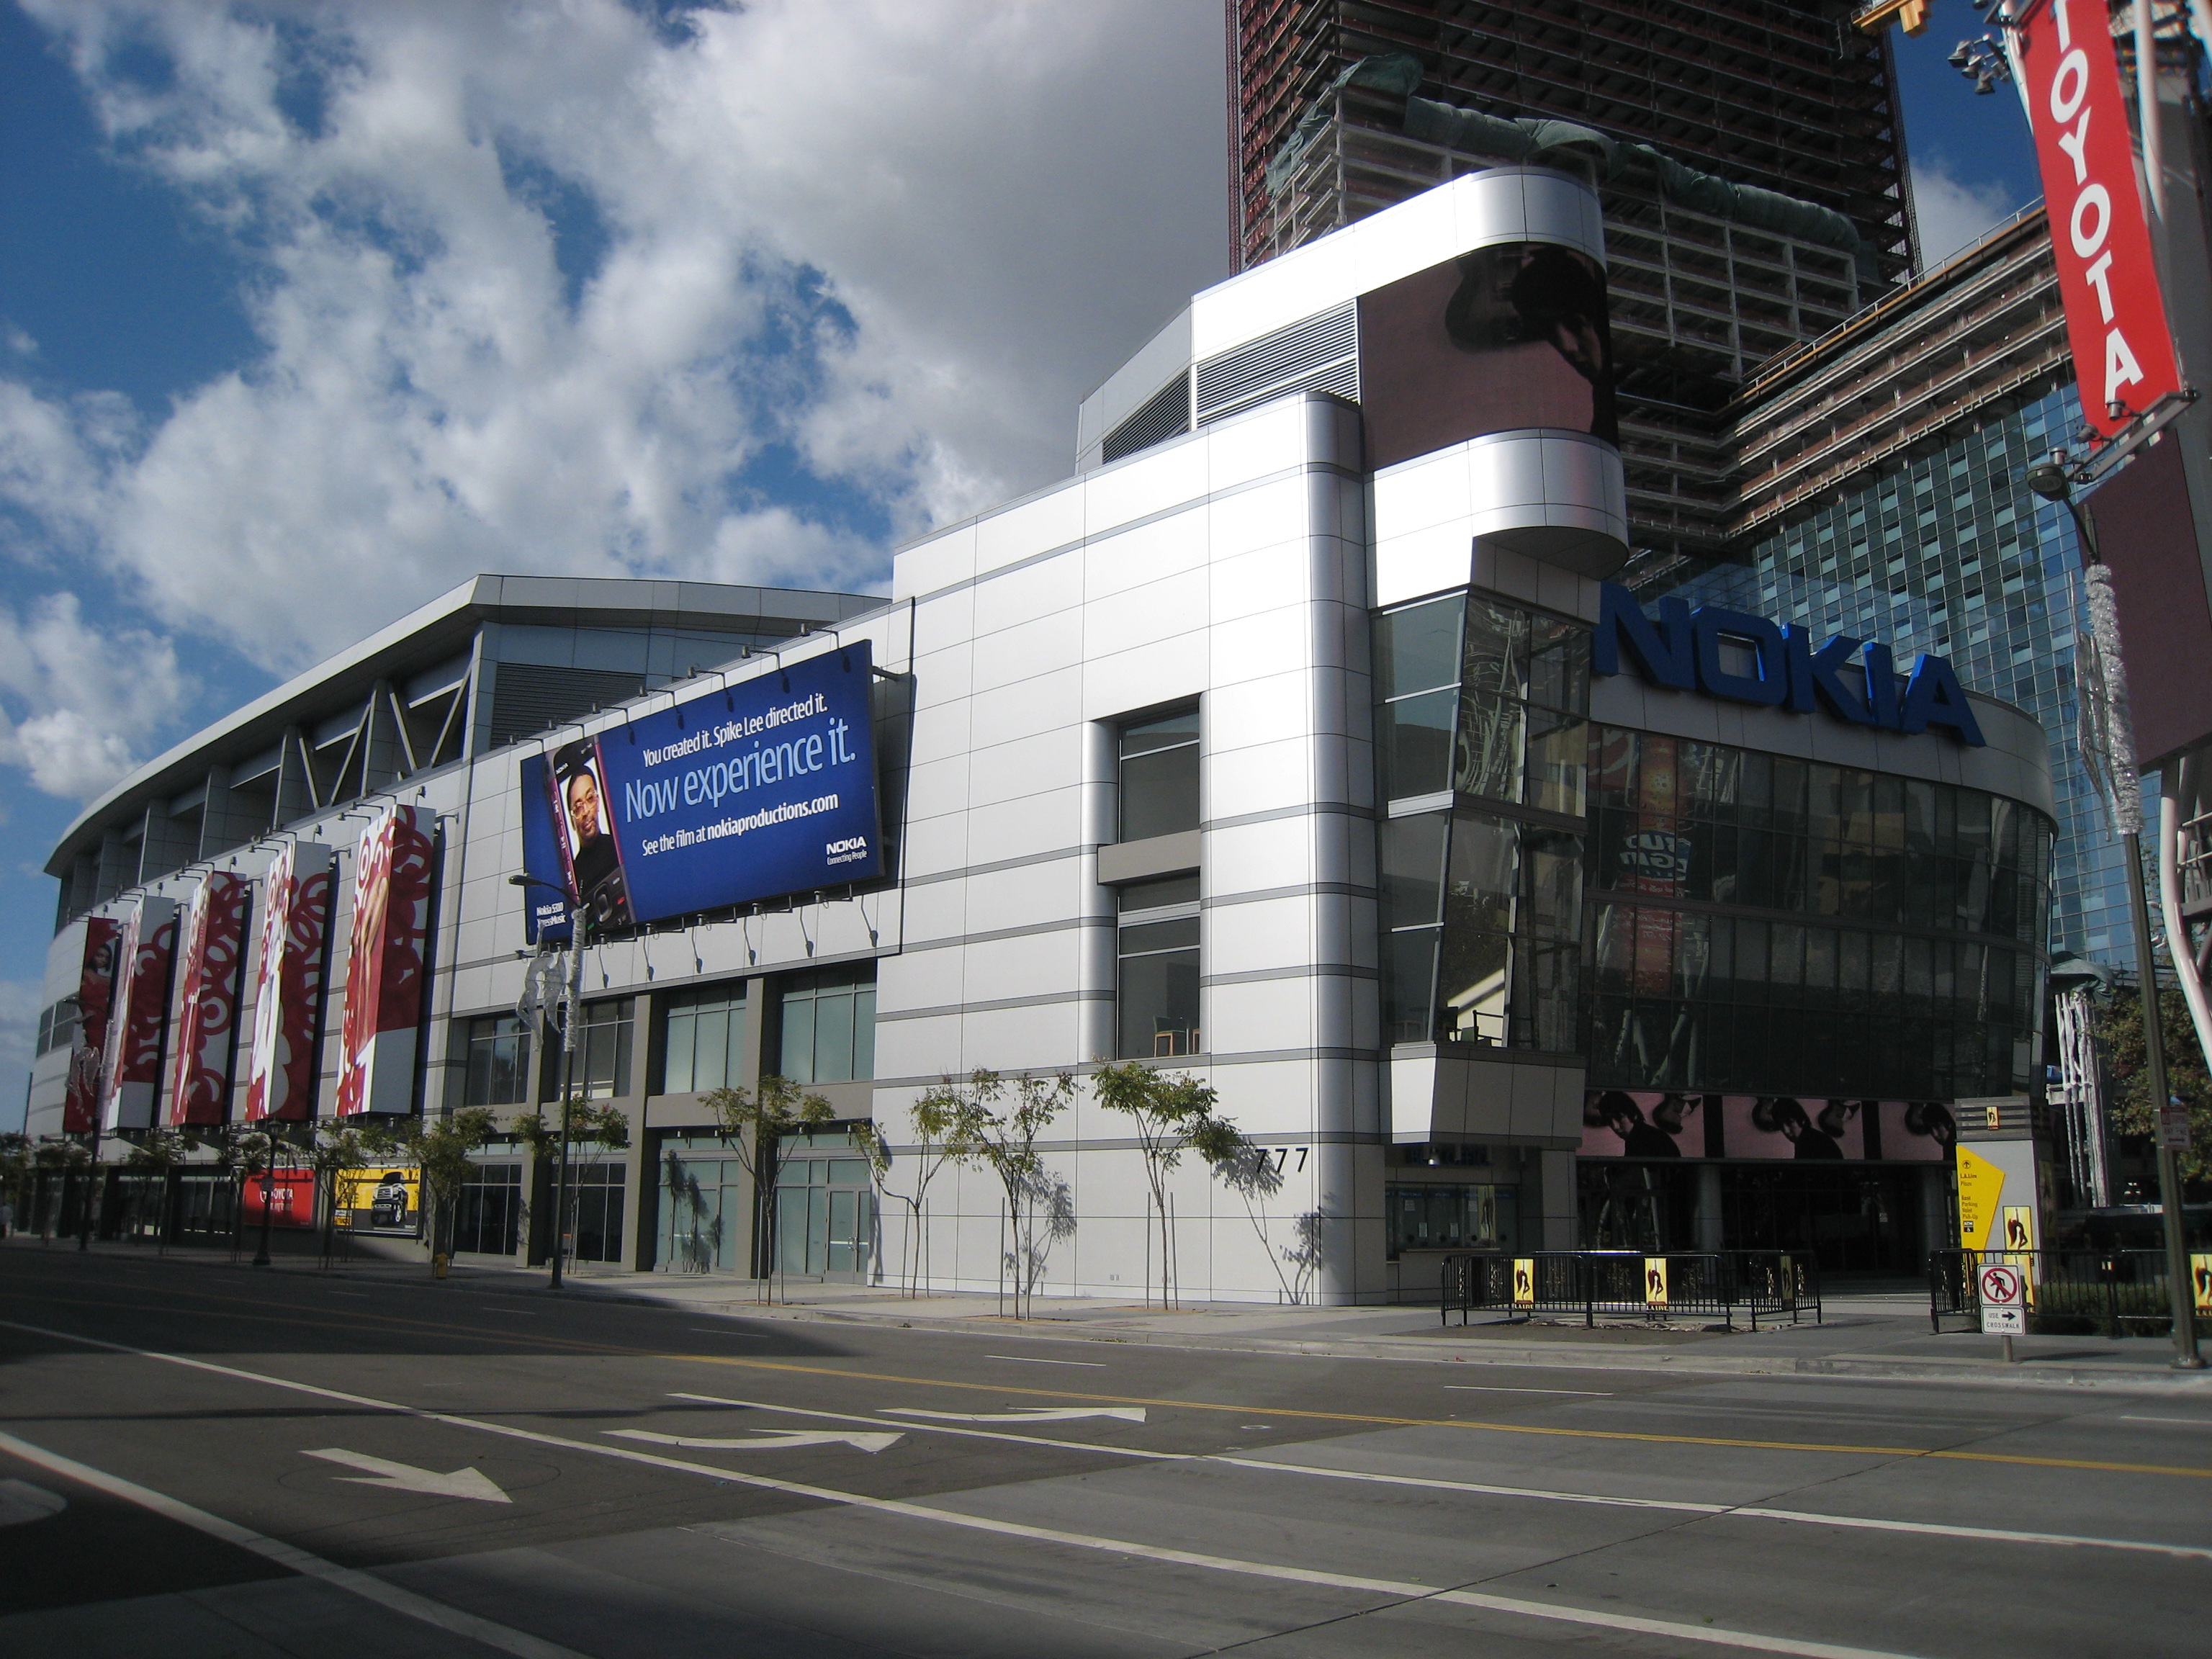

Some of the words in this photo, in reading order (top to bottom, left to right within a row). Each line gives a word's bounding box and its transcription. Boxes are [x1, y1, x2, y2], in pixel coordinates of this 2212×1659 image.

[1590, 580, 1987, 747] NOKIA
[642, 747, 662, 768] You
[662, 730, 701, 761] created
[701, 729, 713, 750] it.
[714, 721, 743, 748] Spike
[744, 715, 764, 736] Lee
[765, 694, 814, 730] directed
[814, 692, 828, 714] it.
[625, 776, 679, 823] Now
[684, 733, 823, 808] experience
[828, 717, 856, 765] it.
[642, 838, 658, 857] See
[660, 833, 675, 851] the
[676, 827, 695, 848] film
[696, 827, 706, 844] at
[707, 793, 839, 841] nokiaproductions.com
[826, 836, 867, 855] NOKIA
[536, 904, 552, 916] Nokia
[1255, 1148, 1308, 1174] 777
